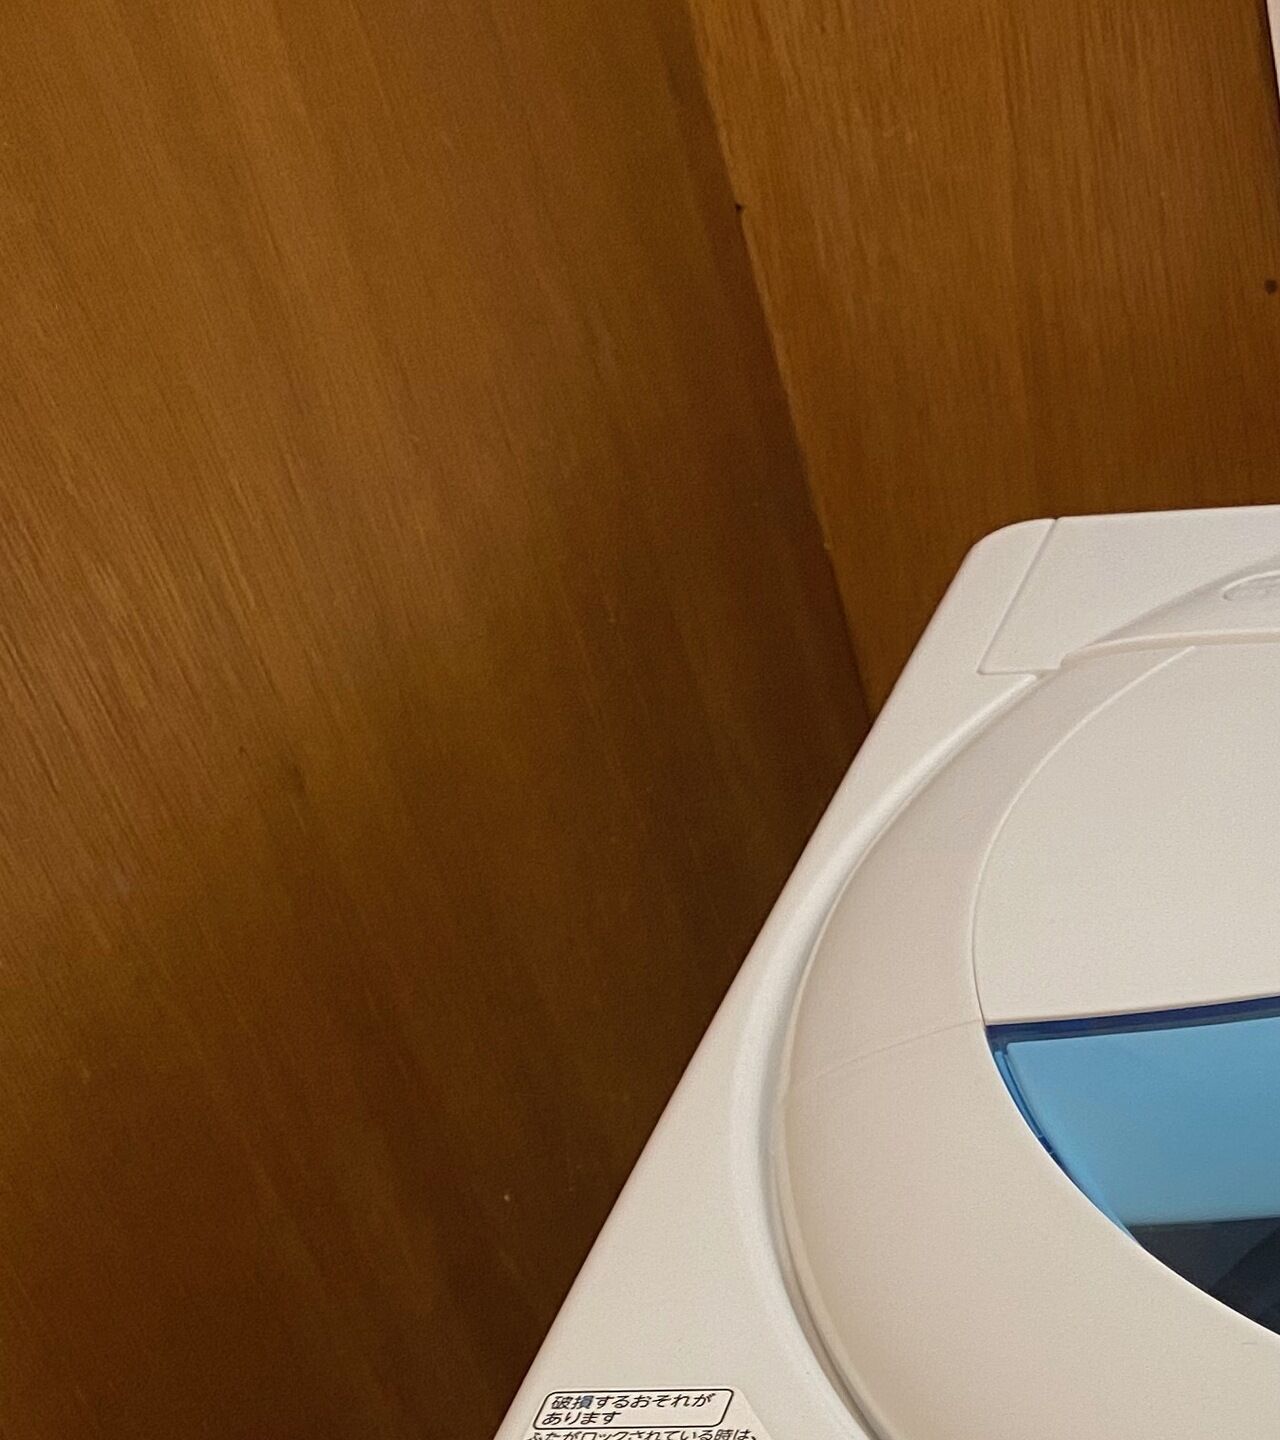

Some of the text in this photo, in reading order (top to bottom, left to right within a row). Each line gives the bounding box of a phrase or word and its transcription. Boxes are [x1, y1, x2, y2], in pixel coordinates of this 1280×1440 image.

[550, 1394, 716, 1410] 破損するおそれが
[542, 1410, 622, 1425] あります
